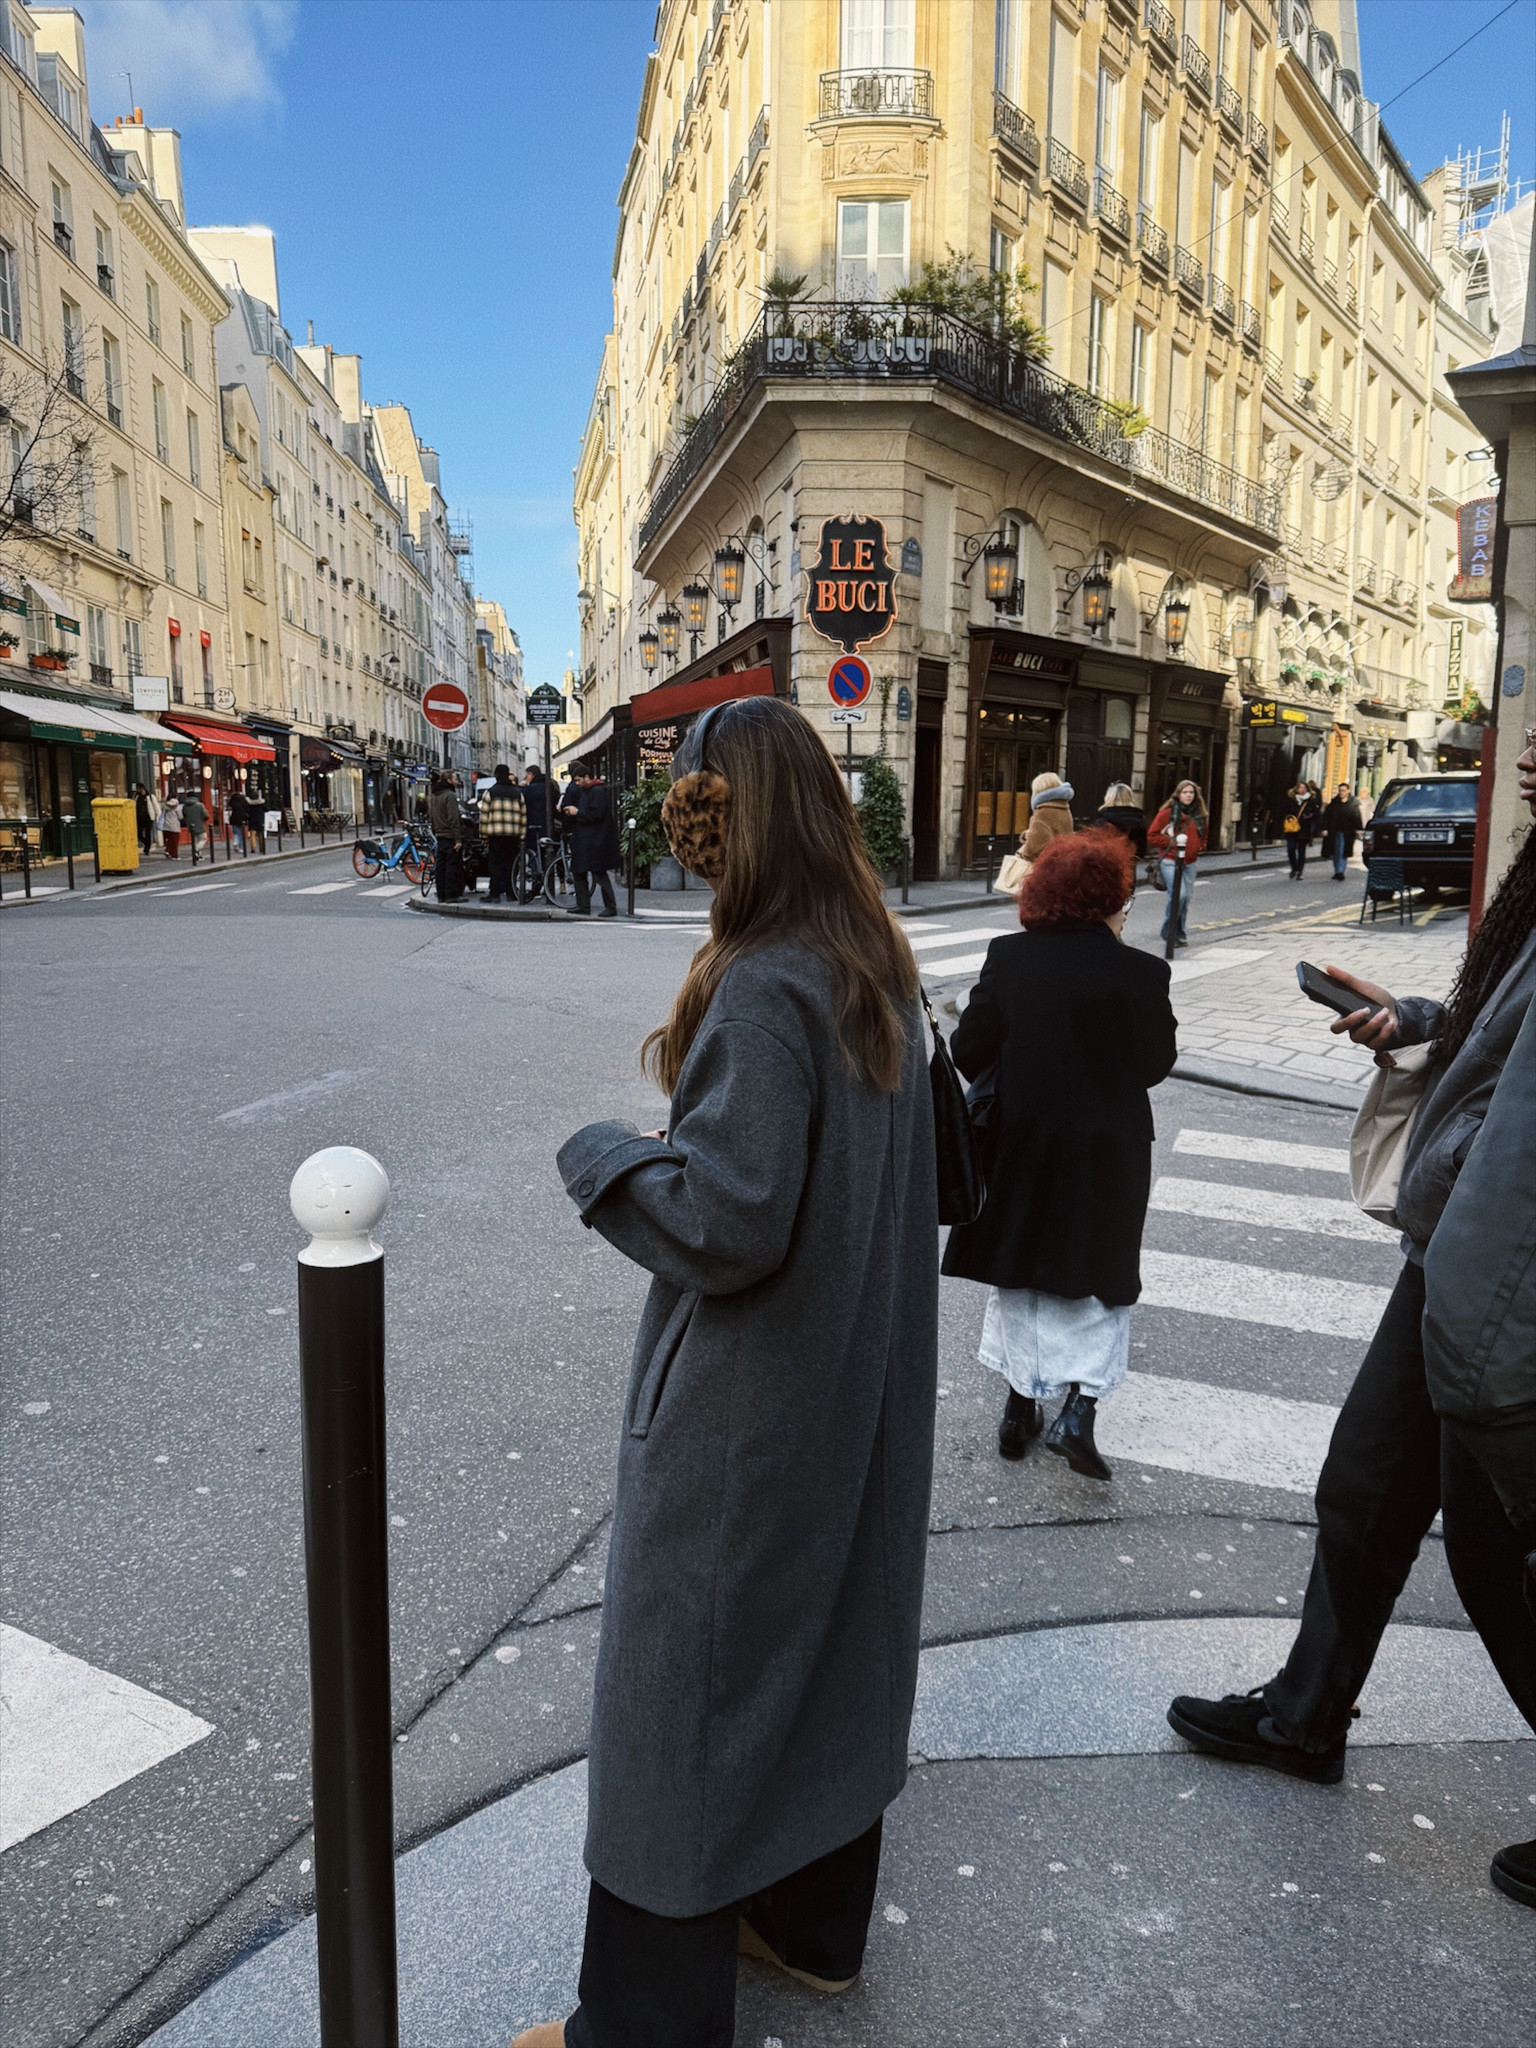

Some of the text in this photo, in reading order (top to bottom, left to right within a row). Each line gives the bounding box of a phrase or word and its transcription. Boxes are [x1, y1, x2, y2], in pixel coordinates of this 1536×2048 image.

[830, 539, 876, 571] LE
[1471, 505, 1490, 576] KEBAB
[815, 580, 889, 612] BUCI
[1014, 652, 1043, 670] BUCI
[1448, 622, 1463, 689] PIZZA
[638, 726, 678, 738] CUISINE
